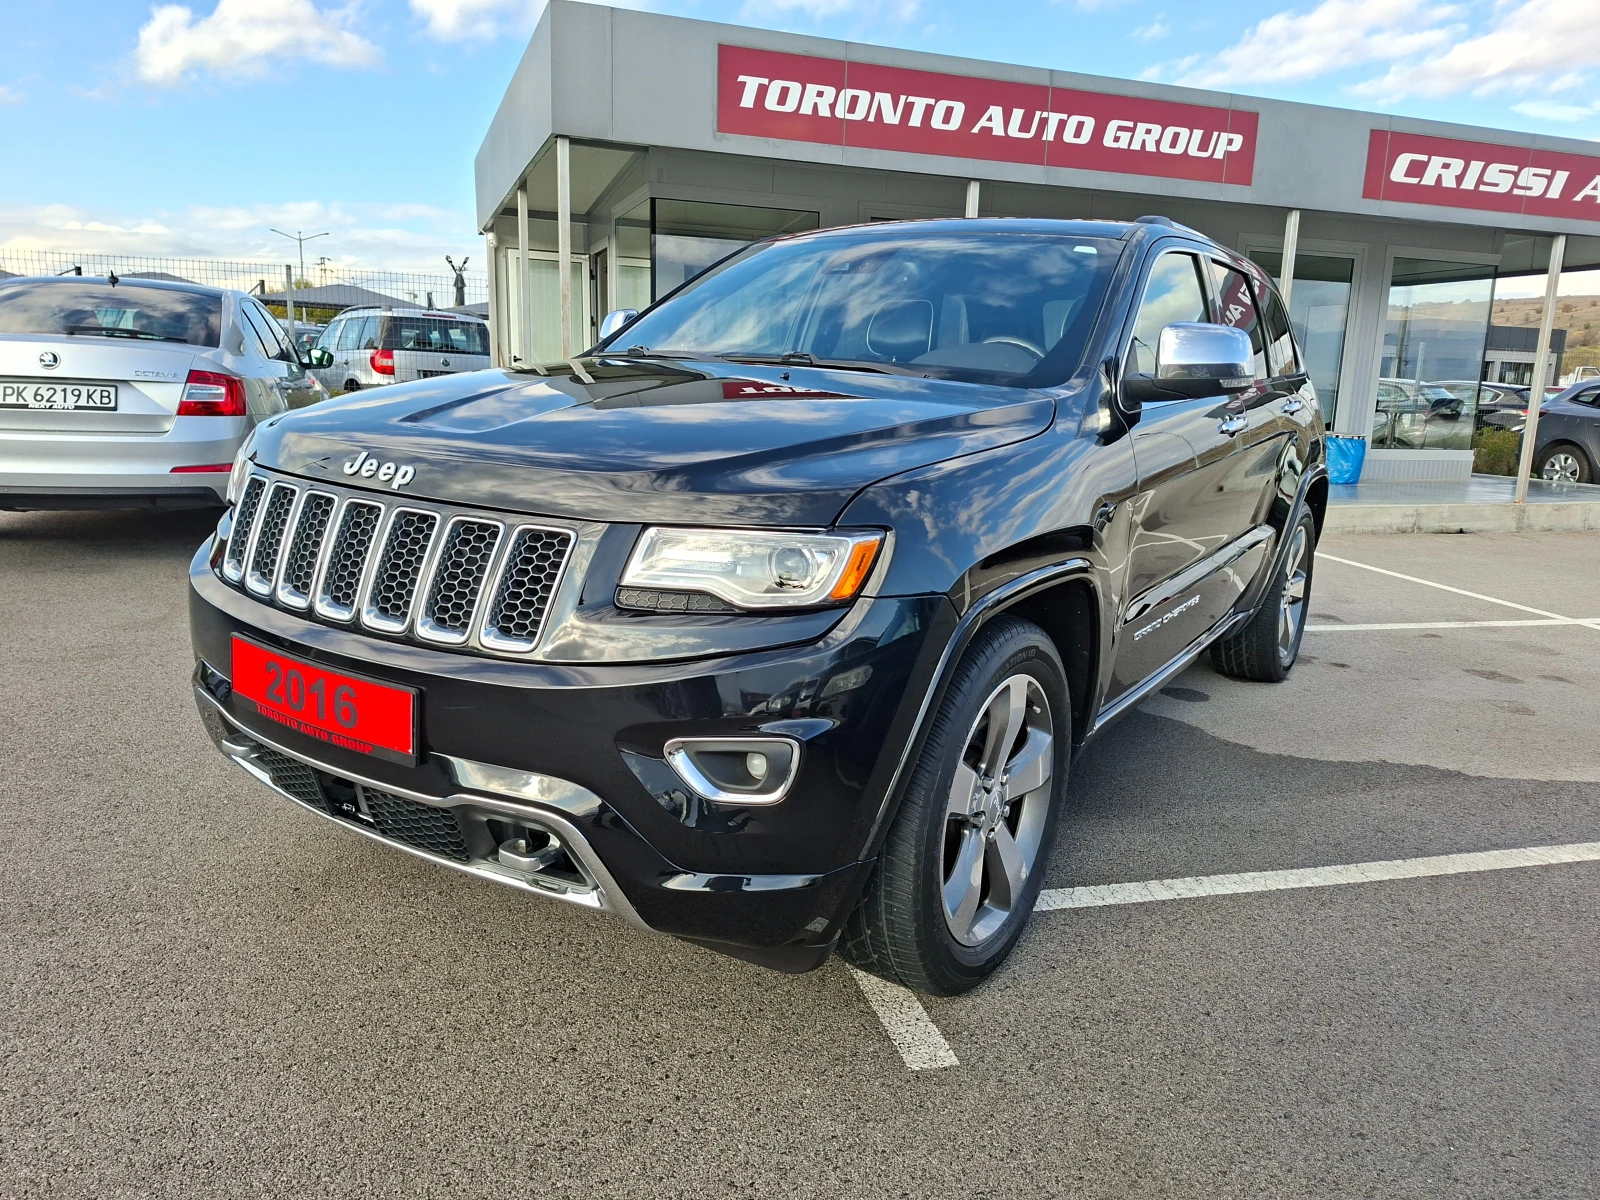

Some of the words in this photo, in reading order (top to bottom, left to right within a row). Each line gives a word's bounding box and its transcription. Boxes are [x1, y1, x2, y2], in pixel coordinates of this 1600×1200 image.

[737, 74, 965, 132] TORONTO
[970, 104, 1096, 145] AUTO
[1102, 119, 1244, 160] GROUP
[1389, 152, 1570, 199] CRISSI
[2, 385, 28, 403] PK
[33, 386, 82, 404] 6219
[86, 388, 113, 406] KB
[134, 369, 180, 379] OCTAVIA
[343, 451, 417, 490] Jeep
[264, 660, 359, 730] 2016
[256, 703, 298, 730] TORONTO
[300, 723, 329, 741] AUTO
[331, 734, 373, 754] GROUP
